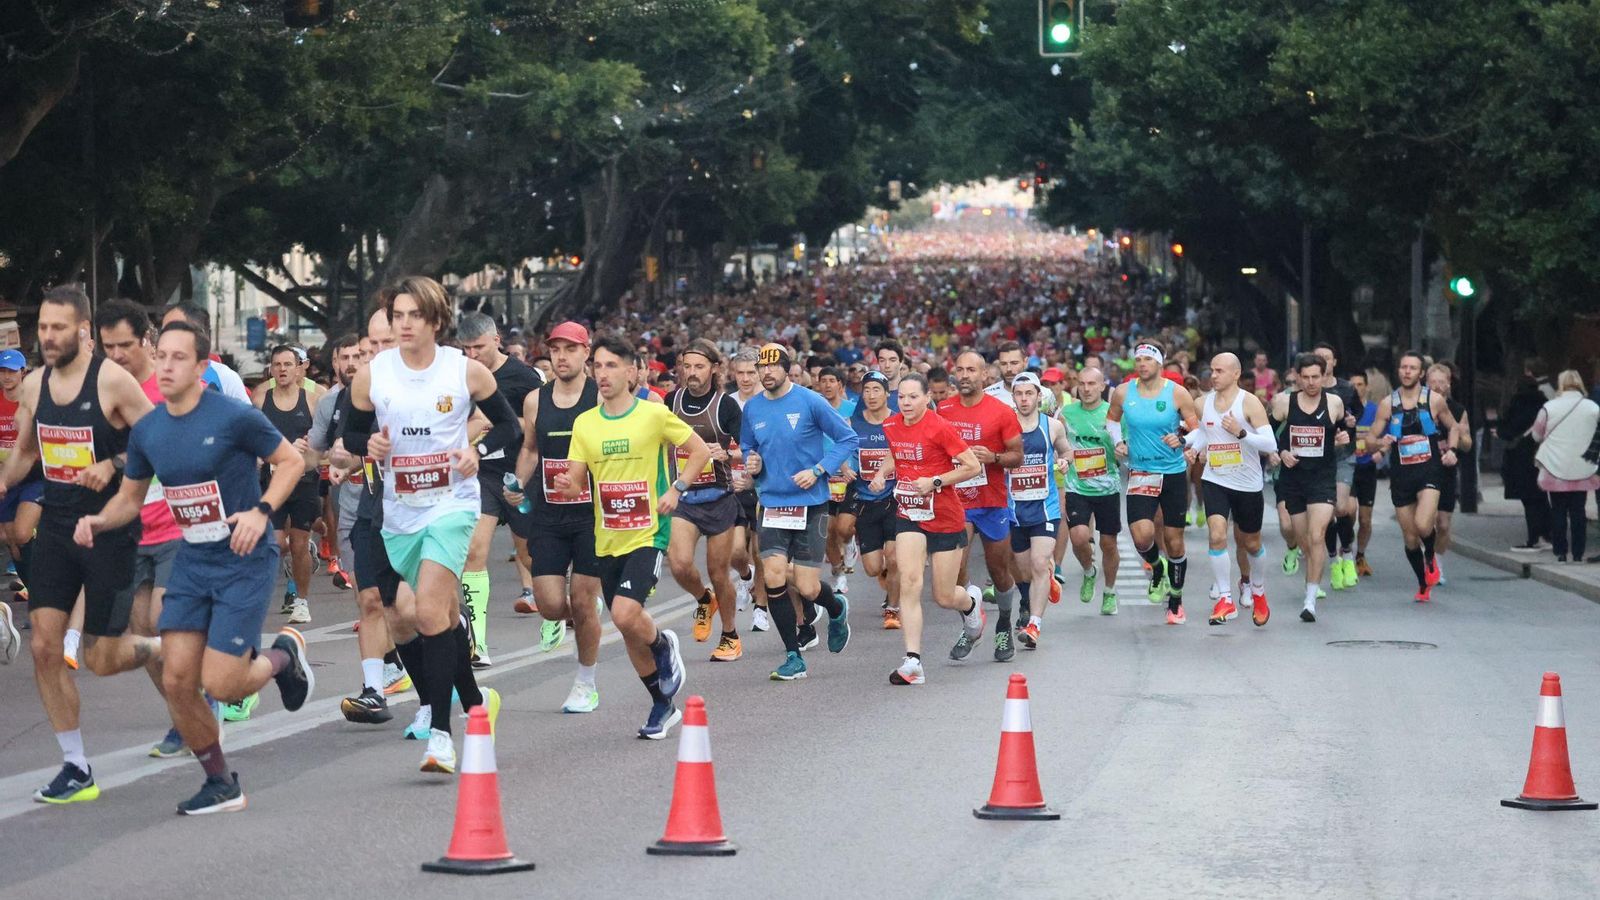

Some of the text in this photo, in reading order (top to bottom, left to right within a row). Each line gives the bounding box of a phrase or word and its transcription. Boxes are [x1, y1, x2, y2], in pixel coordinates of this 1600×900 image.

[757, 348, 779, 363] UFF
[603, 440, 628, 448] MANN
[604, 446, 628, 455] FILTER
[404, 471, 440, 484] 13488
[1017, 477, 1040, 486] 11114
[174, 485, 213, 498] GENERALI
[609, 483, 645, 492] GENERALI
[610, 498, 636, 509] 5543
[900, 496, 924, 505] 10105
[177, 504, 210, 518] 15554
